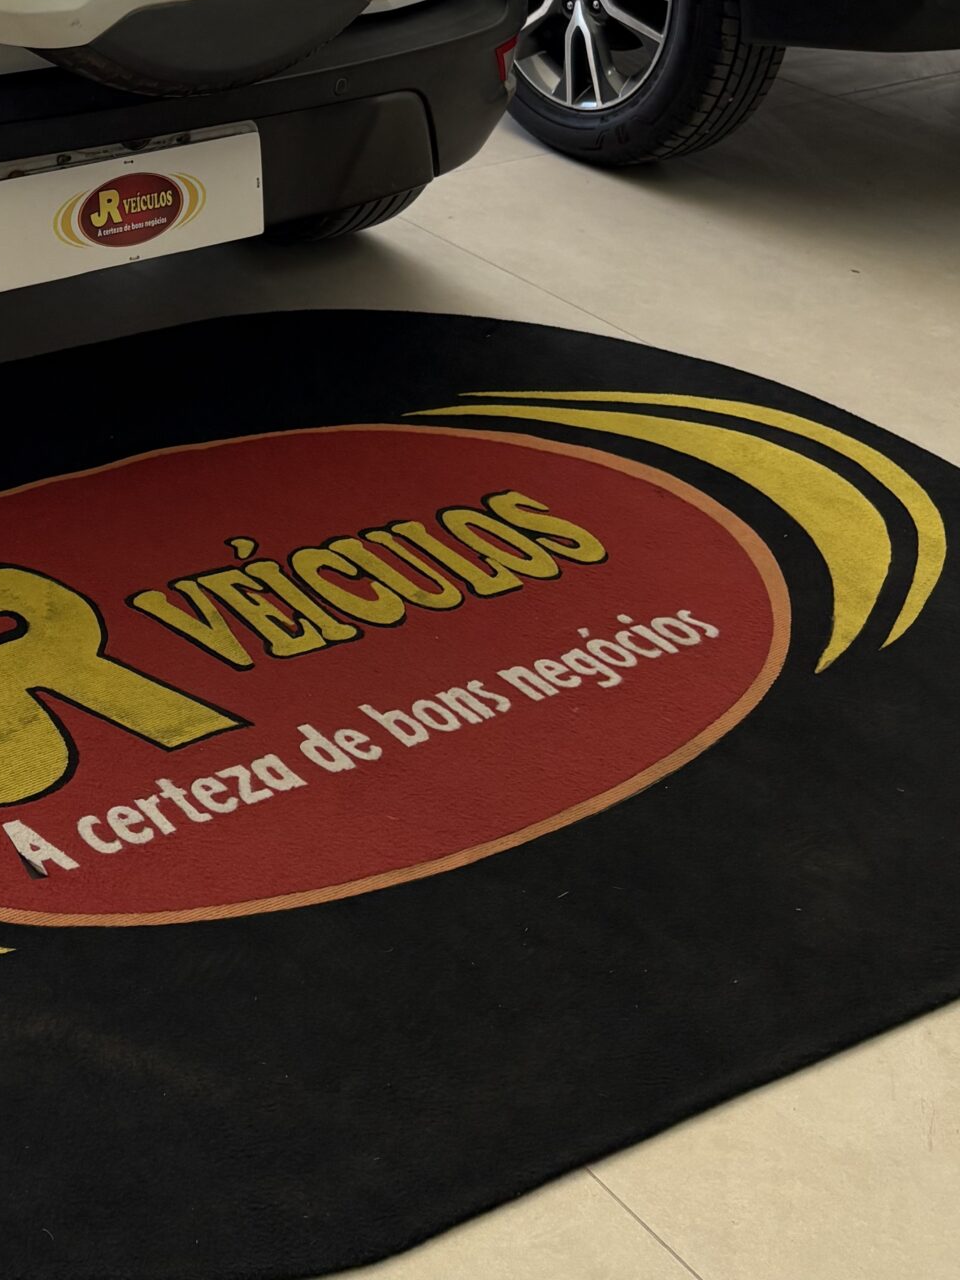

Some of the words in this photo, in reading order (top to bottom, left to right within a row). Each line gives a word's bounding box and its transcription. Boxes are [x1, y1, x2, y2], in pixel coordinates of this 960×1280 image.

[90, 189, 123, 227] JR
[123, 190, 173, 214] VEÍCULOS
[97, 229, 103, 237] A
[103, 226, 123, 236] certeza
[123, 223, 131, 232] de
[131, 221, 144, 230] bons
[124, 489, 609, 671] VEÍCULOS
[2, 819, 80, 877] A
[76, 752, 308, 854] certeza
[296, 723, 382, 772] de
[358, 680, 512, 747] bons
[496, 609, 720, 701] negócios
